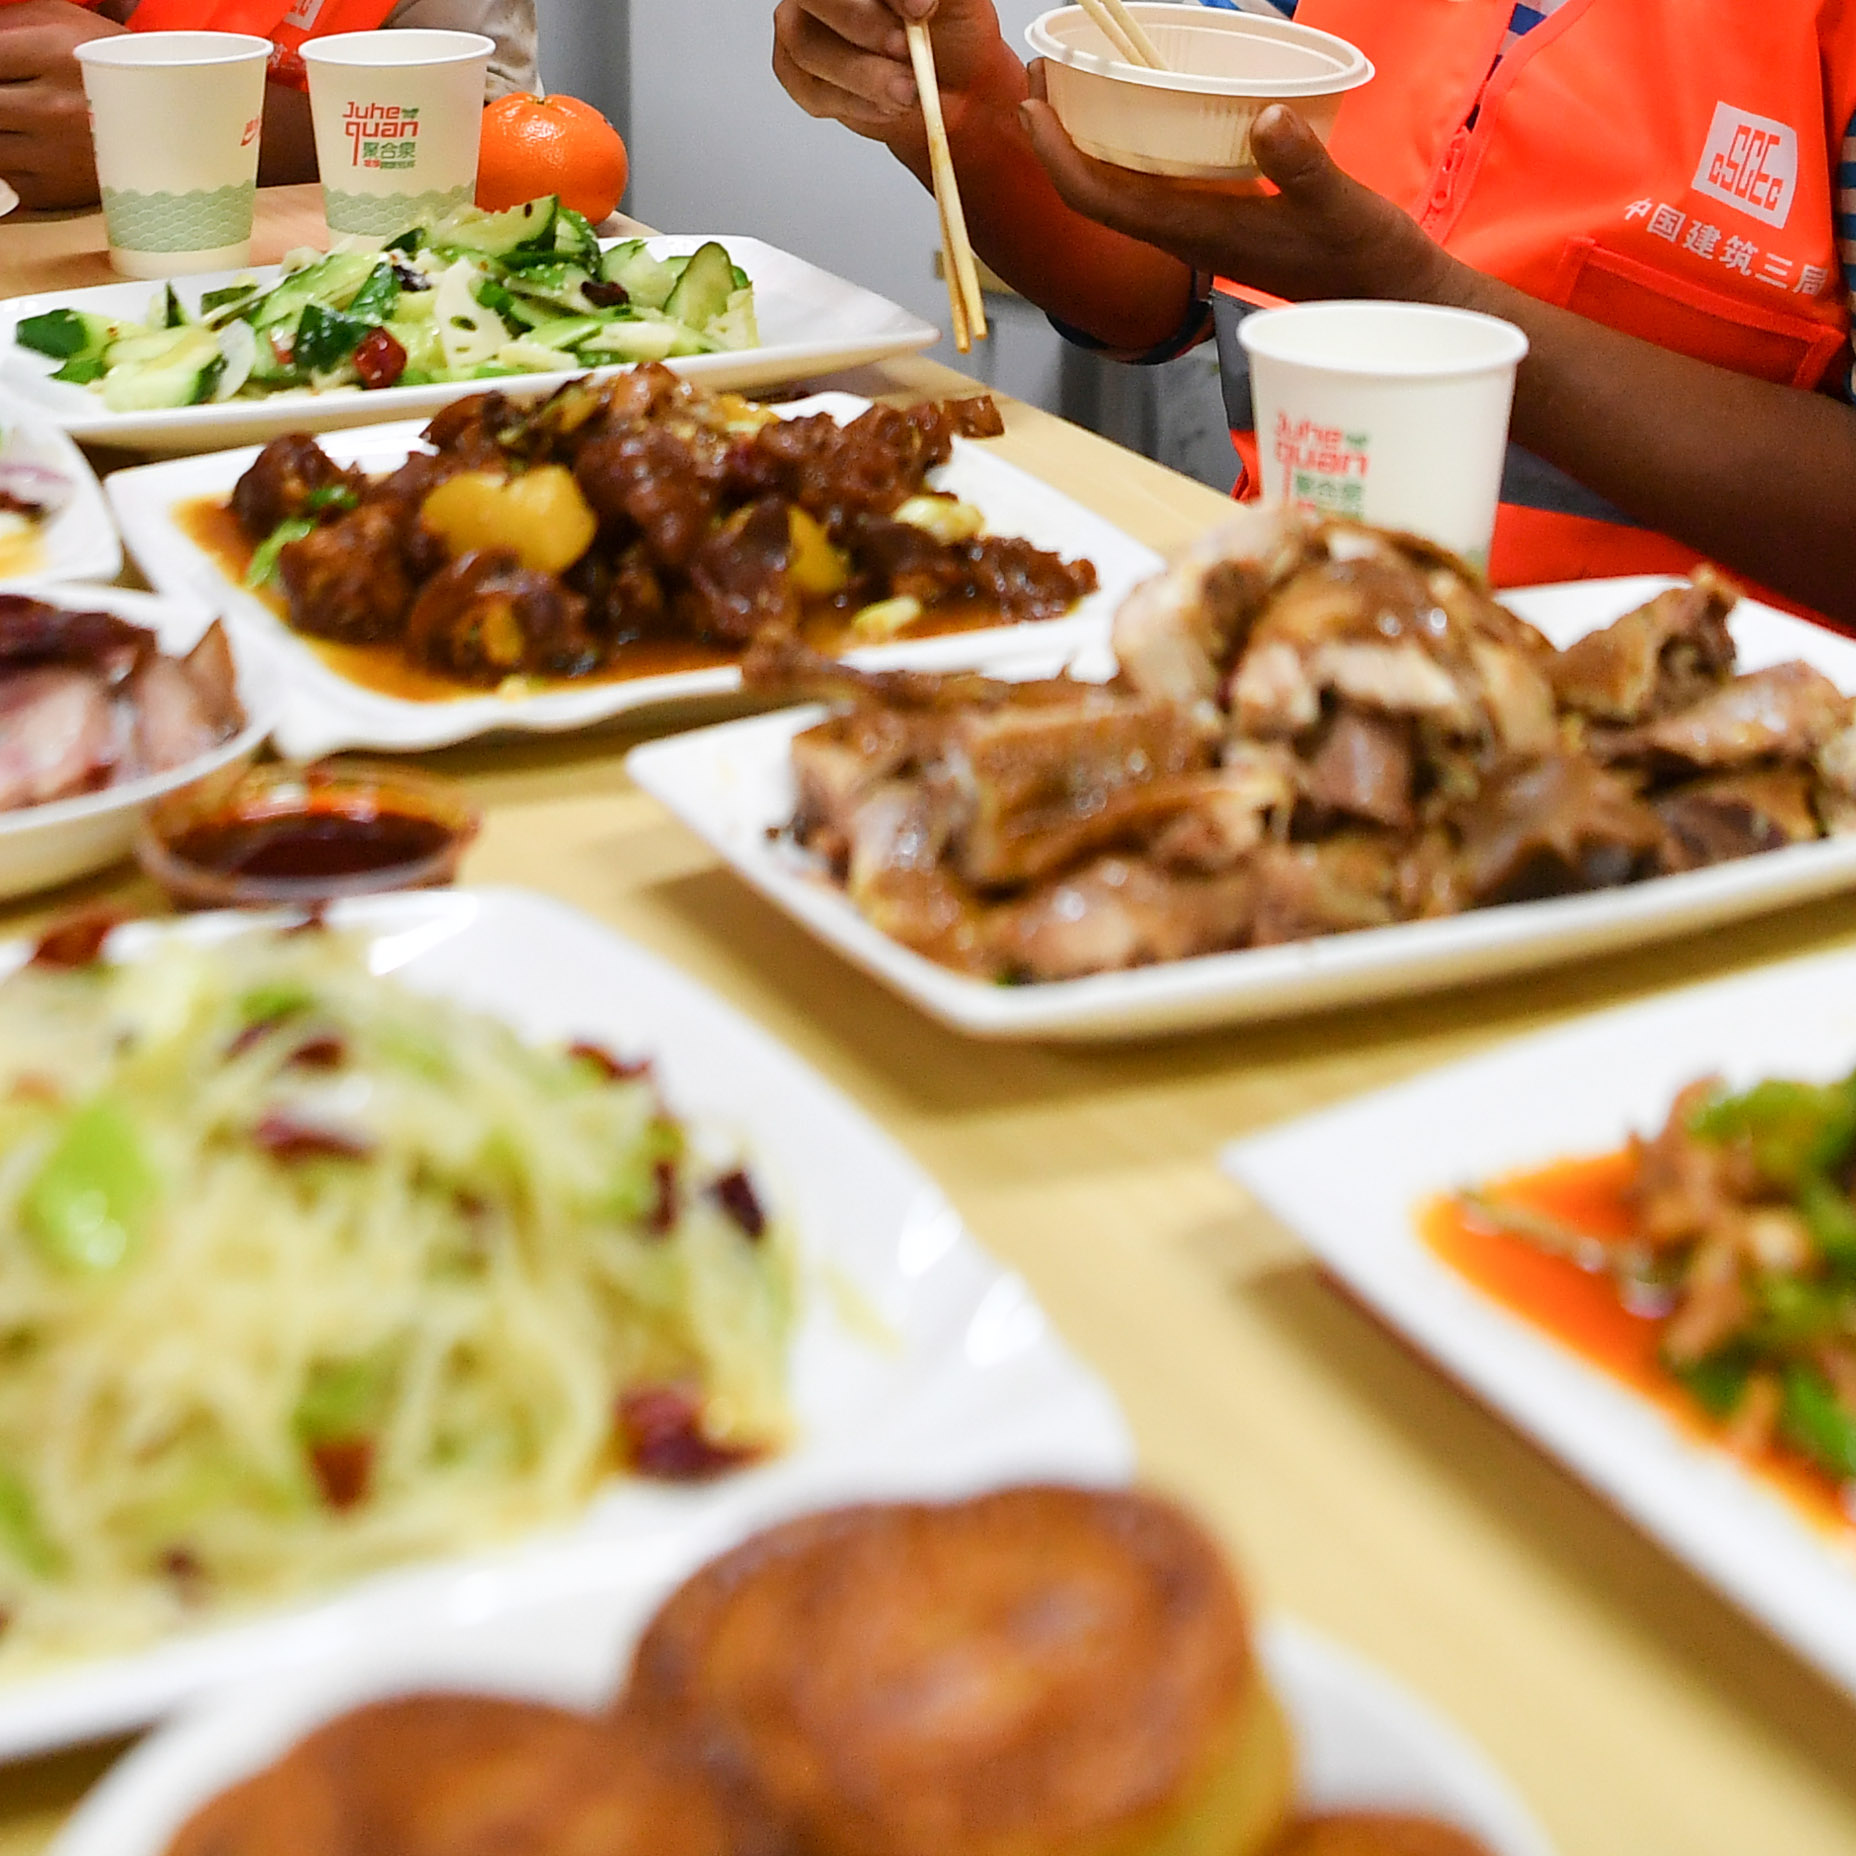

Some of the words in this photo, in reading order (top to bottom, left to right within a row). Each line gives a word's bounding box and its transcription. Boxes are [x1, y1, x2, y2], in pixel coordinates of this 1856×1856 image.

[342, 100, 401, 121] Juhe
[345, 120, 419, 166] quan
[1624, 196, 1829, 296] 中国建筑三局
